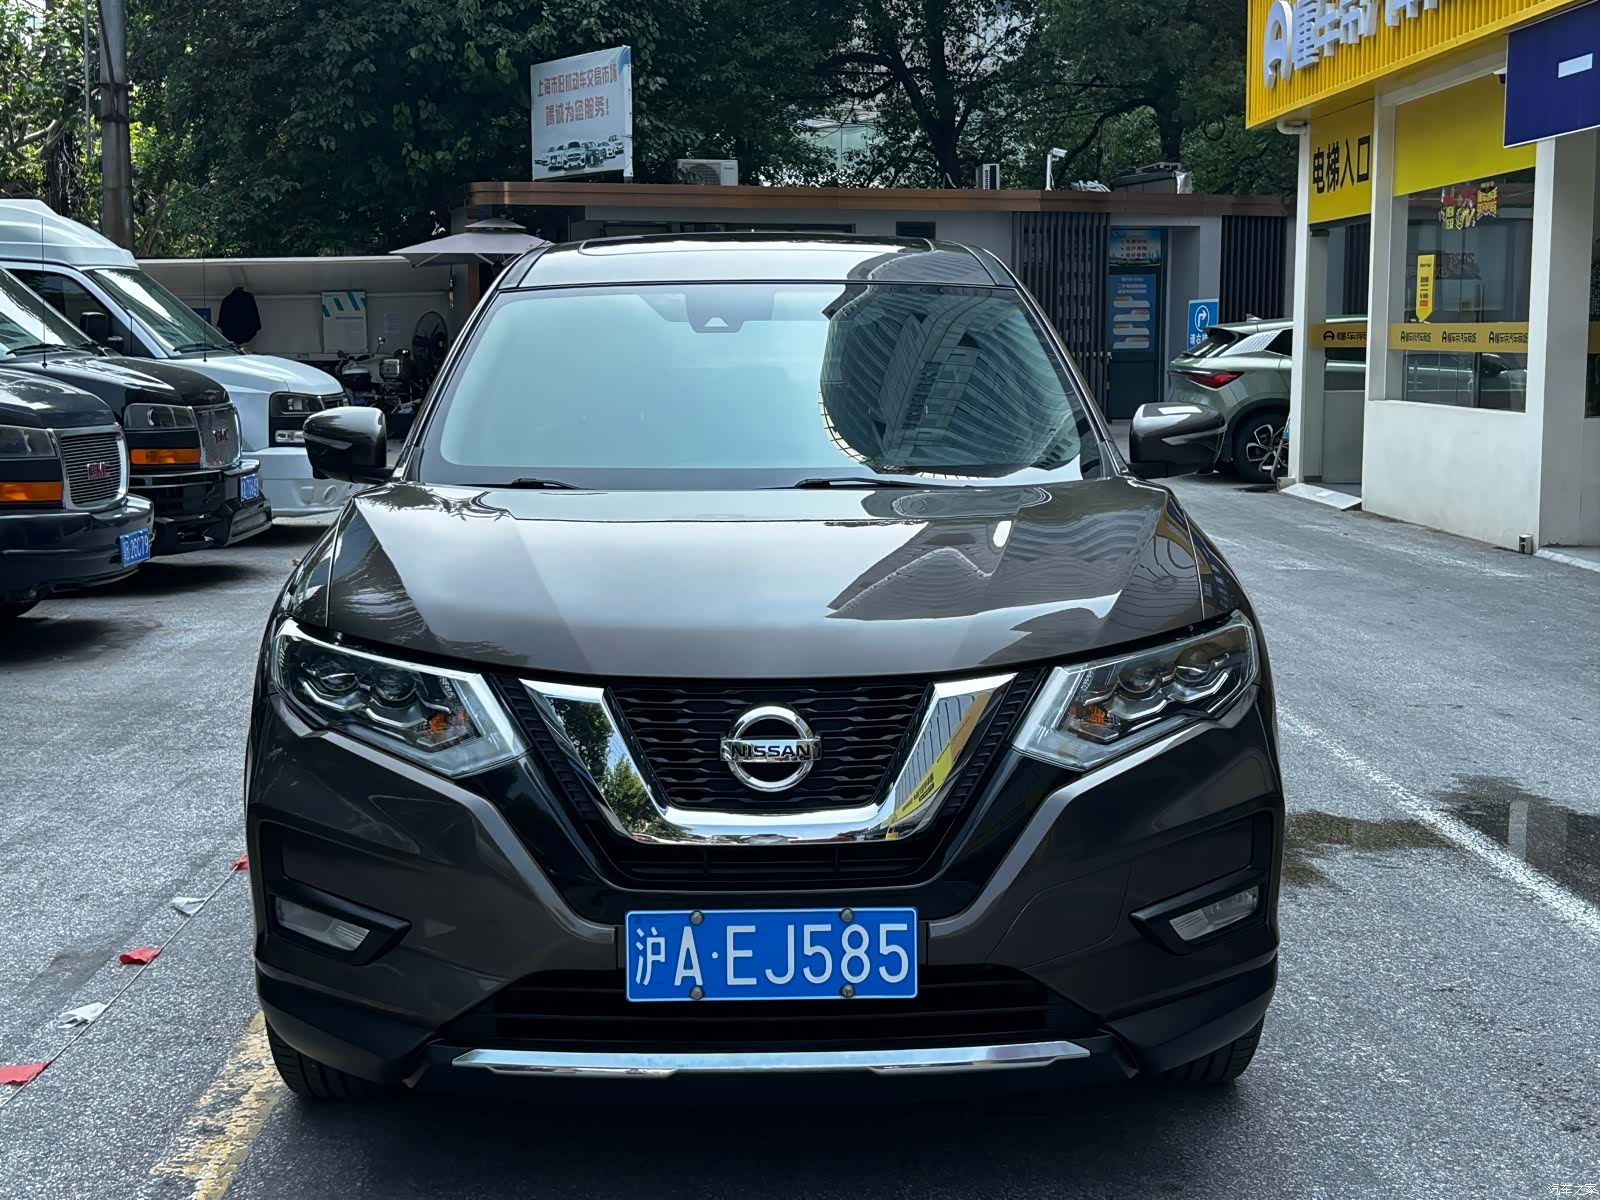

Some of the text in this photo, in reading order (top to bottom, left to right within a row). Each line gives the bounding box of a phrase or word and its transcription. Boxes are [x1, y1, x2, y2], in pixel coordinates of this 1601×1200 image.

[537, 63, 617, 97] 上海市旧机动车交易市场
[1312, 135, 1371, 195] 电梯入口
[731, 744, 811, 760] NISSAN
